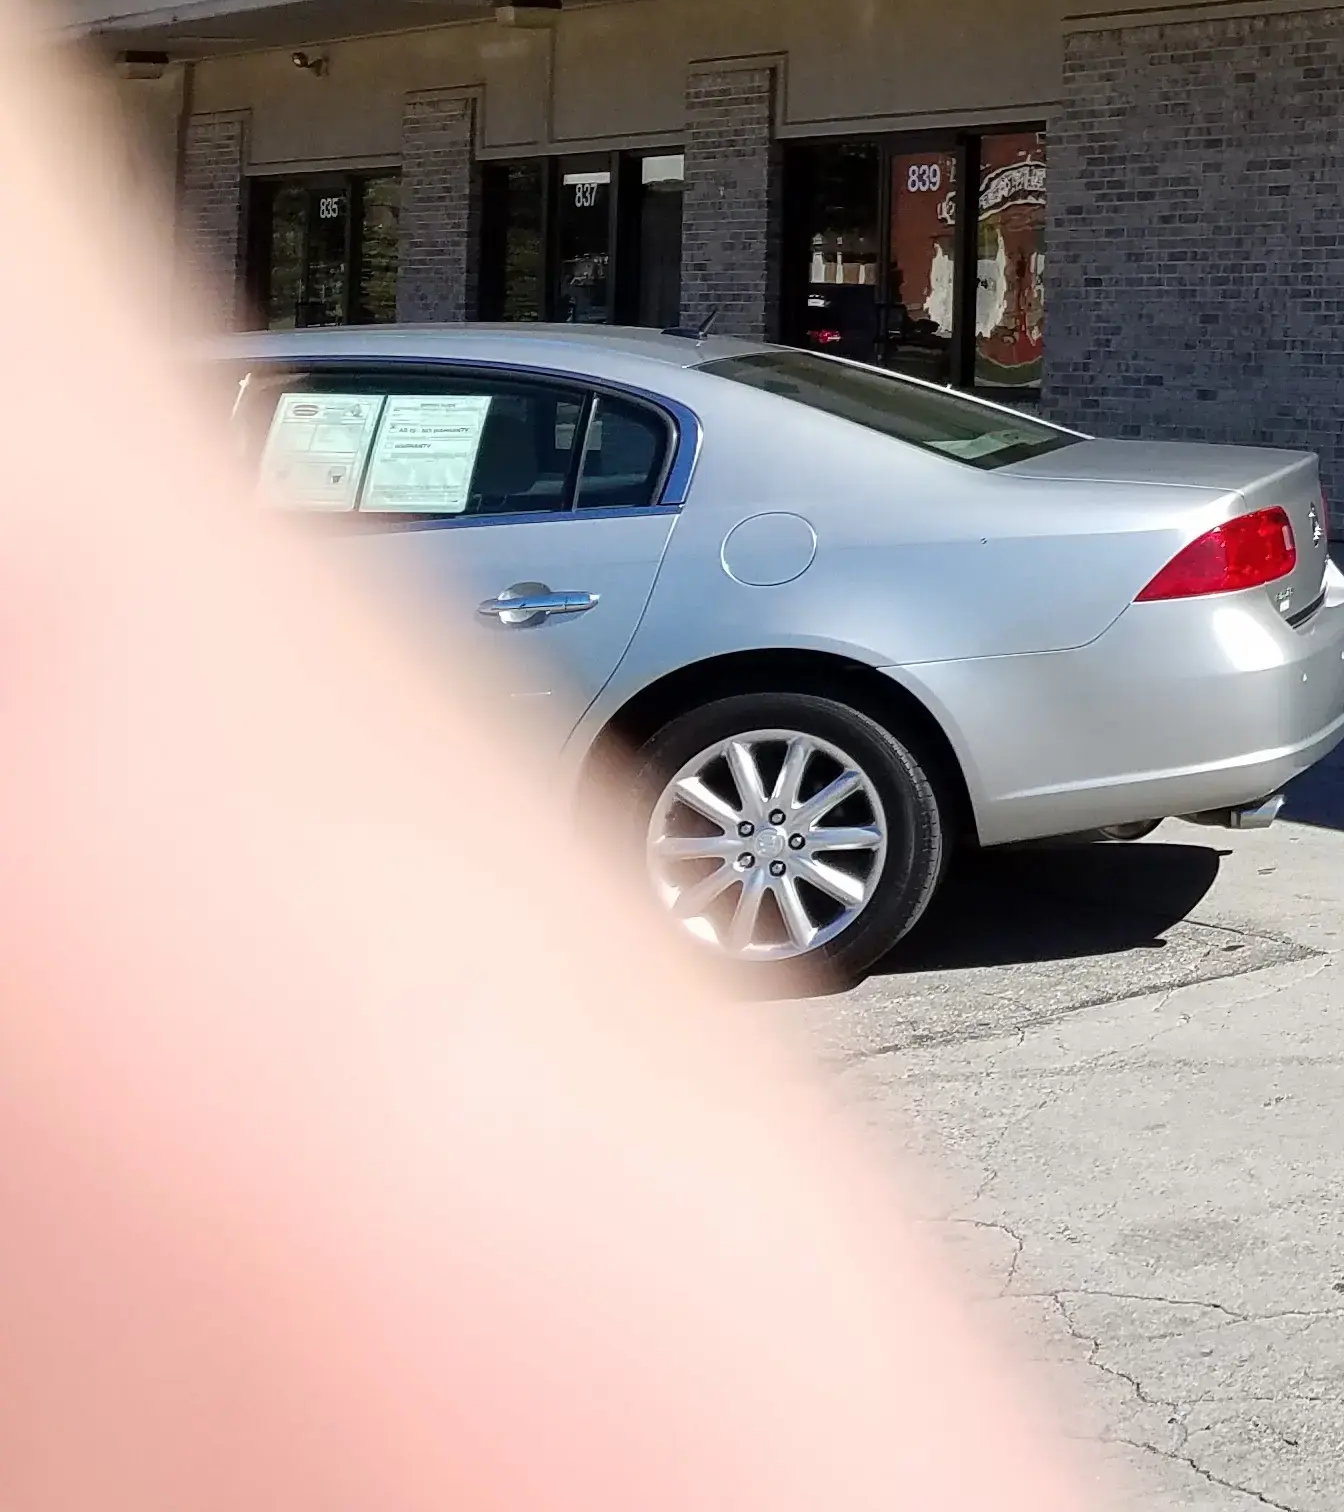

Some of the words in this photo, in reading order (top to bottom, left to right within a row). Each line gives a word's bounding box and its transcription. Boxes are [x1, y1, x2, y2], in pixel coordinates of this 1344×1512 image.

[907, 164, 941, 192] 839
[575, 183, 598, 207] 837
[319, 197, 339, 219] 835
